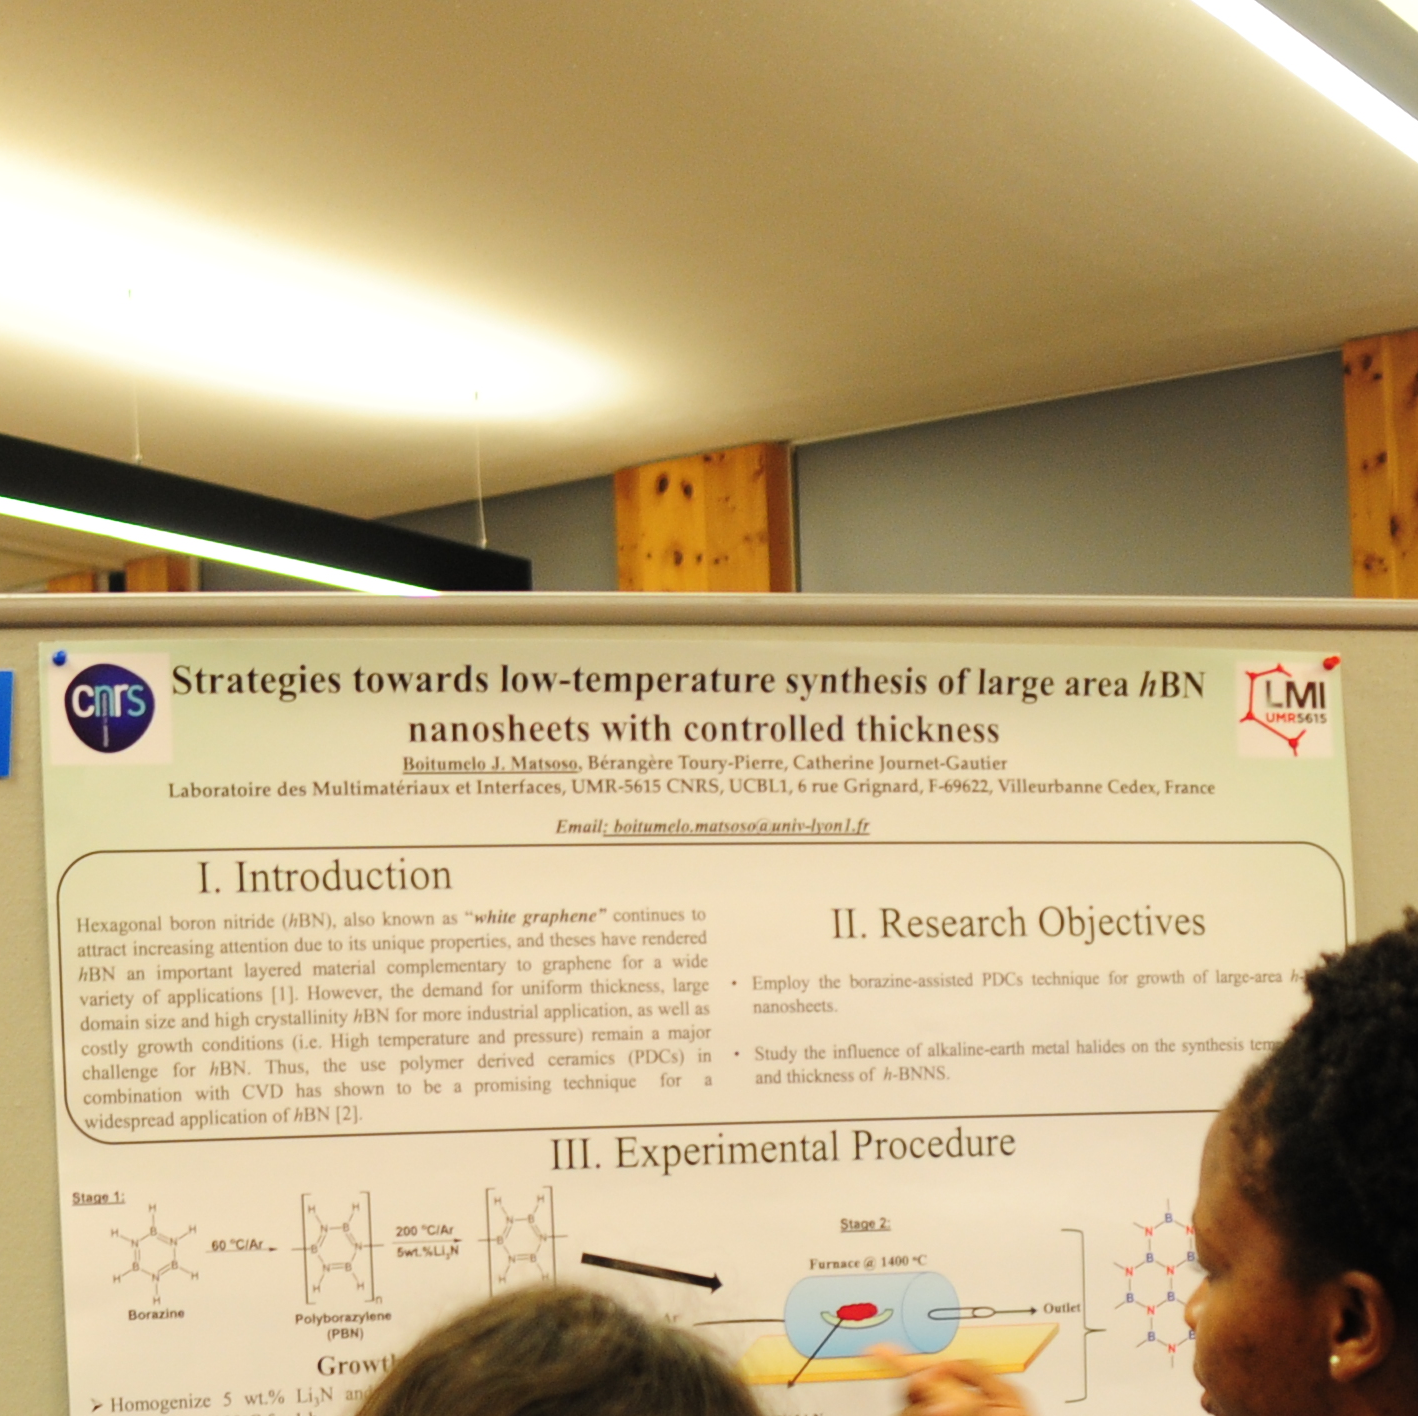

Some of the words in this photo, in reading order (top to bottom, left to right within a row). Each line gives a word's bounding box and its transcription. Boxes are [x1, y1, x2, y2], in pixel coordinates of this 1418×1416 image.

[172, 664, 341, 702] Strategies
[353, 664, 488, 693] towards
[501, 664, 775, 701] low-temperature
[785, 666, 927, 701] synthesis
[937, 667, 971, 695] of
[978, 668, 1054, 703] large
[1065, 677, 1128, 697] area
[1139, 670, 1204, 698] hBN
[71, 684, 146, 718] cnrs
[1266, 680, 1325, 709] LMI
[409, 714, 589, 742] nanosheets
[601, 713, 671, 742] with
[683, 714, 843, 742] controlled
[856, 714, 999, 742] thickness
[1266, 713, 1327, 724] UMR5615
[402, 755, 486, 772] Boitumelo
[491, 756, 506, 772] J.
[511, 755, 583, 774] Matsoso,
[587, 754, 673, 774] Bérangère
[677, 754, 789, 774] Toury-Pierre,
[792, 753, 874, 770] Catherine
[878, 754, 1008, 773] Journet-Gautier
[168, 781, 271, 798] Laboratoire
[277, 781, 307, 797] des
[312, 779, 449, 796] Multimatériaux
[455, 780, 471, 795] et
[476, 778, 566, 796] Interfaces,
[571, 778, 661, 794] UMR-5615
[666, 777, 724, 796] CNRS,
[729, 777, 793, 796] UCBL1,
[797, 778, 807, 793] 6
[811, 782, 839, 793] rue
[843, 778, 923, 798] Grignard,
[928, 778, 993, 795] F-69622,
[997, 778, 1103, 794] Villeurbanne
[1107, 779, 1160, 796] Cedex,
[1165, 779, 1215, 795] France
[555, 819, 608, 835] Email:
[199, 861, 220, 894] I.
[236, 857, 451, 892] Introduction
[76, 915, 161, 936] Hexagonal
[169, 915, 216, 931] boron
[223, 913, 275, 930] nitride
[281, 912, 337, 930] (hBN),
[343, 911, 375, 927] also
[381, 910, 435, 926] known
[441, 914, 458, 925] as
[464, 908, 517, 924] “white
[521, 907, 607, 928] graphene”
[612, 907, 685, 922] continues
[691, 909, 706, 921] to
[831, 907, 867, 938] II.
[879, 906, 1027, 938] Research
[1038, 904, 1205, 945] Objectives
[77, 943, 127, 958] attract
[133, 939, 215, 959] increasing
[219, 937, 289, 954] attention
[293, 936, 323, 952] due
[327, 938, 343, 952] to
[348, 935, 367, 951] its
[371, 934, 425, 954] unique
[429, 933, 511, 954] properties,
[516, 931, 545, 948] and
[549, 931, 596, 947] theses
[600, 931, 637, 946] have
[641, 929, 707, 946] rendered
[751, 974, 809, 994] Employ
[818, 974, 841, 990] the
[849, 971, 973, 989] borazine-assisted
[981, 971, 1023, 987] PDCs
[1031, 970, 1099, 989] technique
[1107, 969, 1129, 985] for
[1135, 969, 1185, 989] growth
[1192, 969, 1209, 984] of
[1215, 969, 1283, 988] large-area
[752, 998, 837, 1014] nanosheets.
[754, 1045, 797, 1064] Study
[803, 1044, 826, 1060] the
[833, 1043, 900, 1059] influence
[905, 1042, 923, 1058] of
[927, 1040, 1025, 1058] alkaline-earth
[1031, 1039, 1069, 1055] metal
[1075, 1038, 1125, 1054] halides
[1131, 1042, 1149, 1053] on
[1154, 1038, 1175, 1053] the
[1181, 1036, 1245, 1056] synthesis
[755, 1069, 781, 1085] and
[786, 1068, 855, 1084] thickness
[858, 1066, 876, 1082] of
[883, 1065, 949, 1081] h-BNNS.
[85, 1111, 175, 1132] widespread
[179, 1108, 267, 1130] application
[271, 1106, 291, 1123] of
[293, 1106, 329, 1122] hBN
[335, 1105, 362, 1125] [2].
[551, 1138, 601, 1170] III.
[615, 1129, 838, 1174] Experimental
[853, 1126, 1015, 1161] Procedure
[72, 1192, 109, 1204] Stage
[396, 1226, 418, 1237] 200
[840, 1218, 876, 1232] Stage
[211, 1239, 226, 1251] 60
[809, 1258, 860, 1270] Furnace
[881, 1256, 909, 1268] 1400
[128, 1309, 185, 1321] Borazine
[295, 1310, 392, 1325] Polyborazylene
[1043, 1303, 1081, 1314] Outlet
[327, 1328, 364, 1341] (PBN)
[111, 1393, 211, 1416] Homogenize
[223, 1392, 232, 1406] 5
